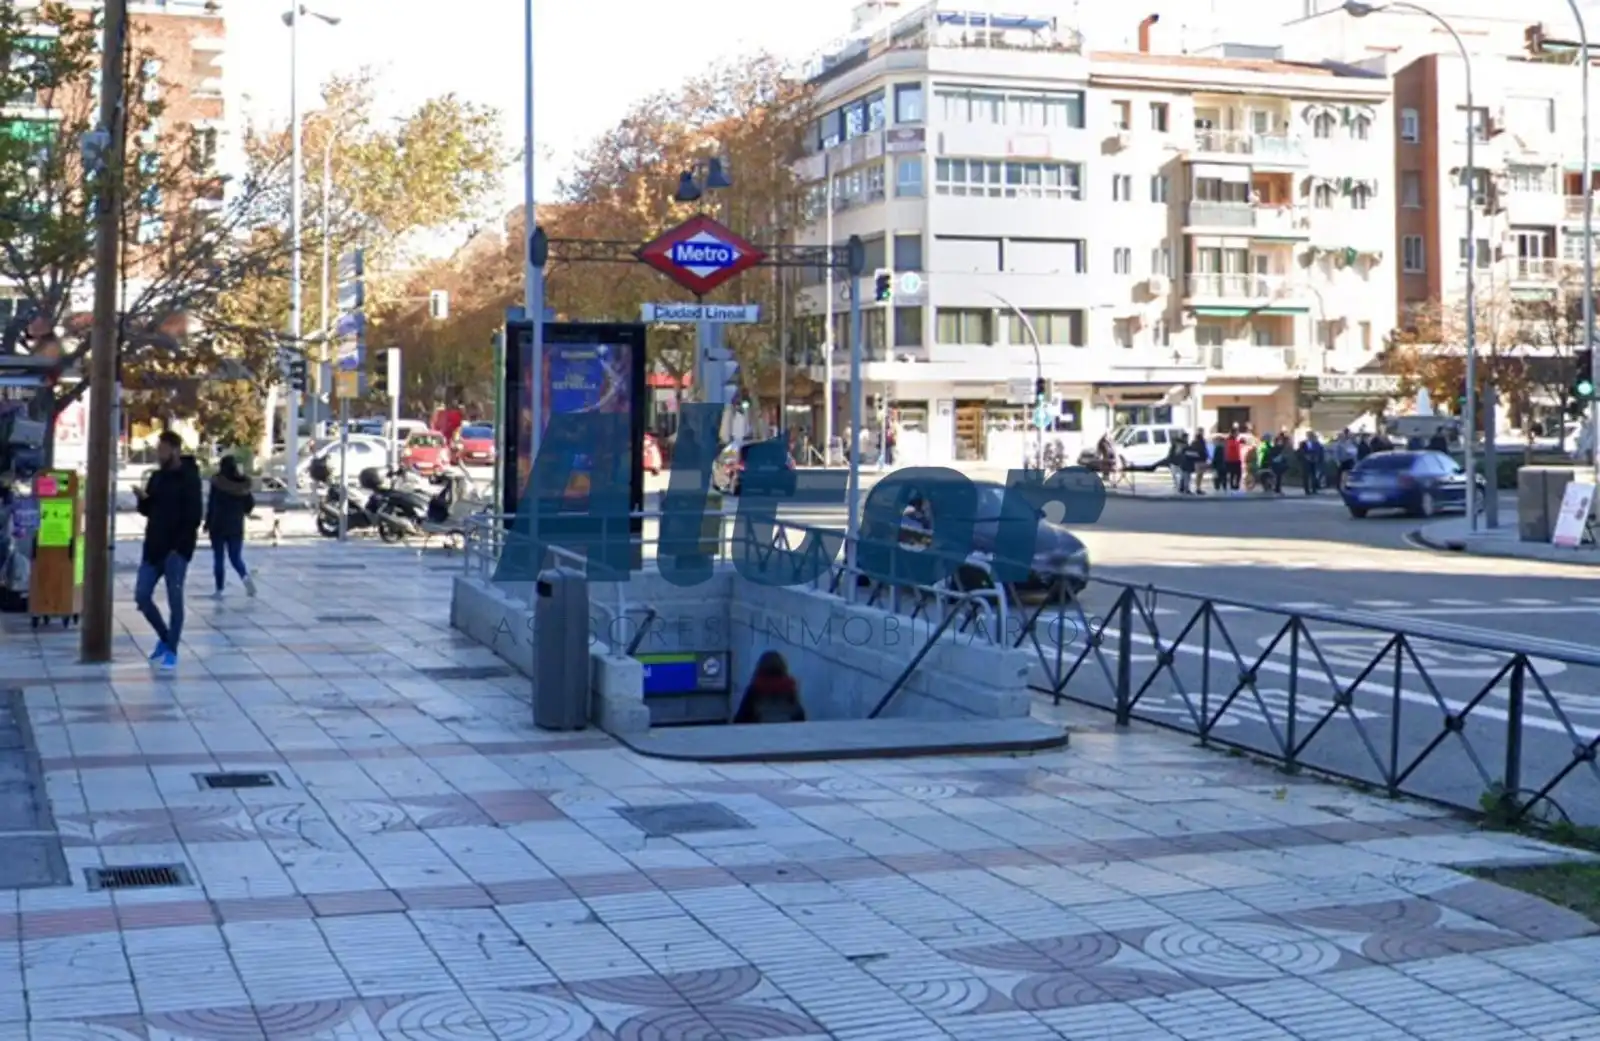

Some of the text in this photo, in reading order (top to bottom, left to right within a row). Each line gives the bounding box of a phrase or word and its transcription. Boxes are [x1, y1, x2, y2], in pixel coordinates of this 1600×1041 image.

[675, 243, 730, 262] Metro
[655, 305, 747, 320] Ciudad Lineal
